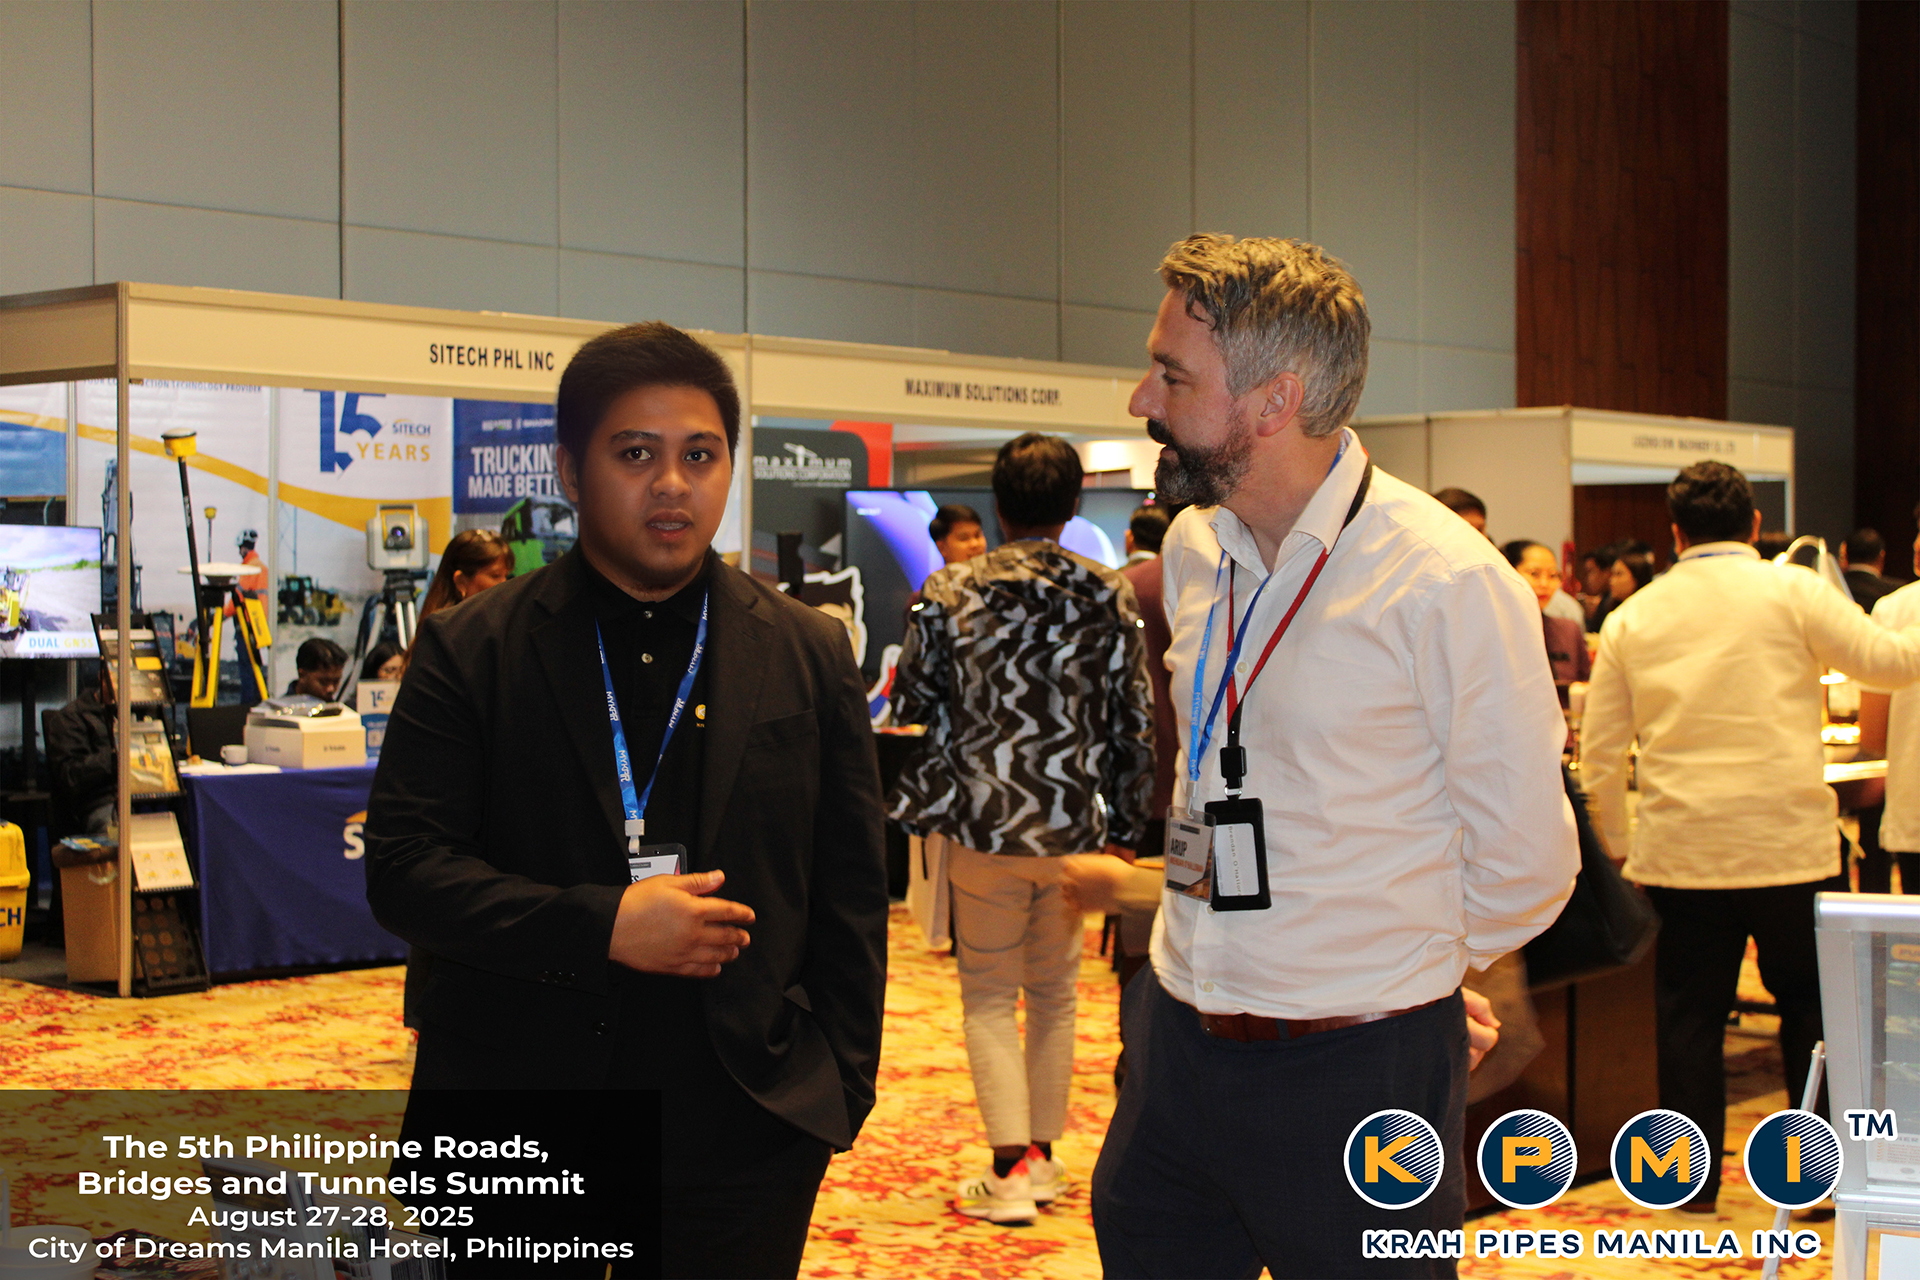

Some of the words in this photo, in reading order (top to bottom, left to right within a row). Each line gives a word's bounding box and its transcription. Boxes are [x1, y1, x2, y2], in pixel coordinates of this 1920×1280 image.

[429, 343, 488, 367] SITECH
[494, 347, 523, 369] PHL
[528, 349, 555, 371] INC
[905, 378, 962, 399] MAXIMUM
[966, 382, 1029, 404] SOLUTIONS
[392, 422, 431, 436] SITECH
[356, 442, 431, 462] YEARS
[471, 444, 555, 475] TRUCKIN
[468, 474, 513, 499] MADE
[514, 473, 559, 498] BETT
[28, 636, 60, 649] DUAL
[63, 637, 95, 649] GNSS
